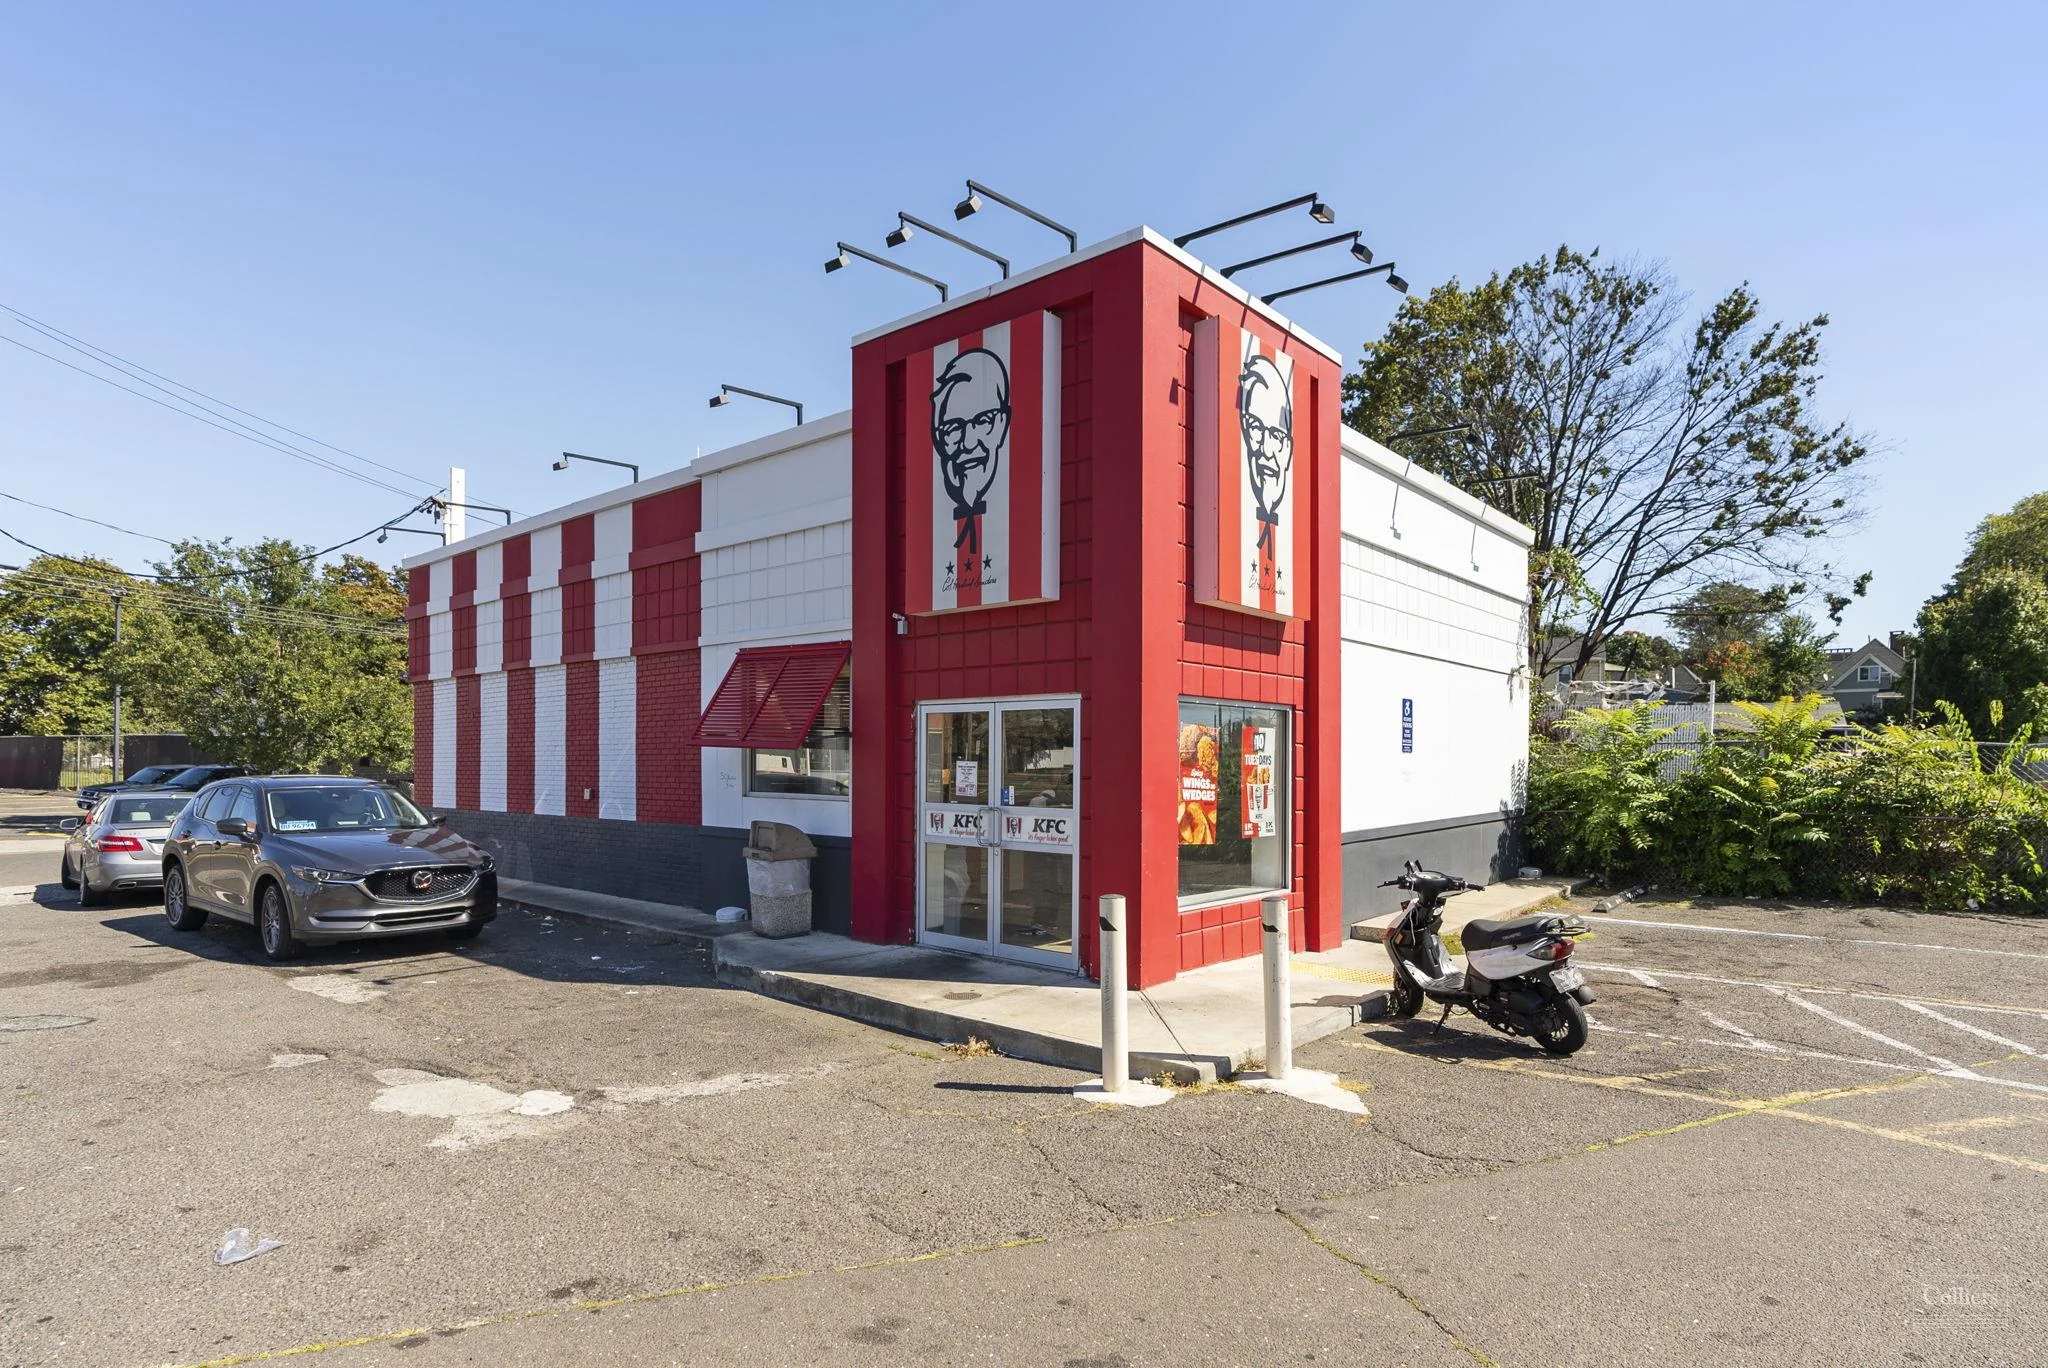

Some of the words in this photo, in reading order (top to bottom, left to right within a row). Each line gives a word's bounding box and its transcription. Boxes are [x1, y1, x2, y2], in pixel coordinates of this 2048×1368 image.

[1183, 777, 1210, 789] WINGS
[1182, 789, 1216, 801] WEDGES
[953, 814, 983, 829] KFC
[1032, 818, 1066, 834] KFC
